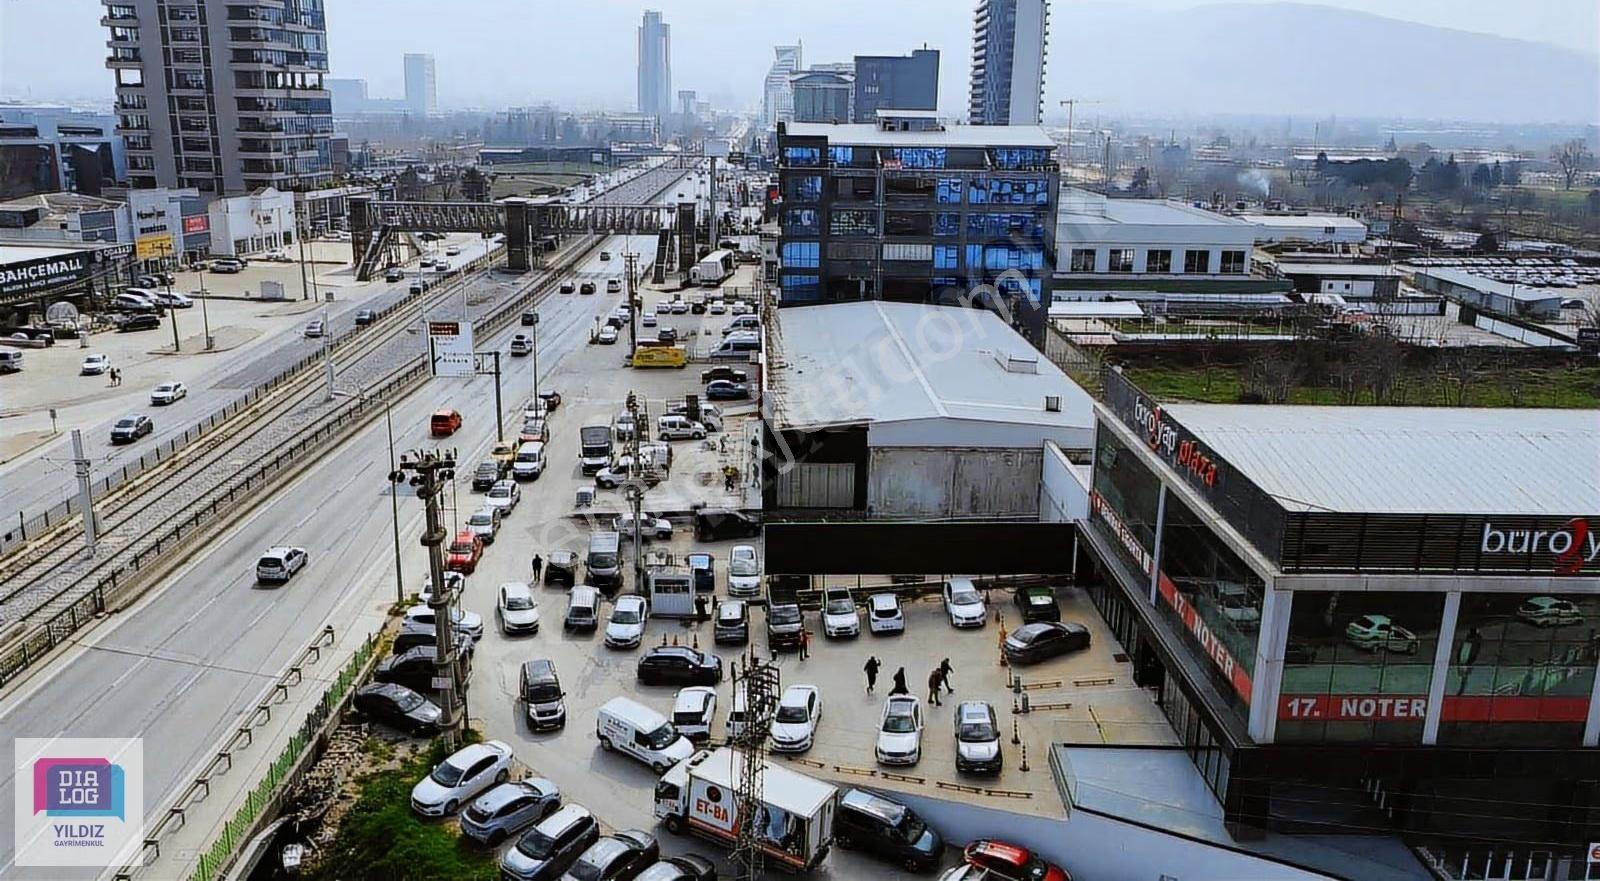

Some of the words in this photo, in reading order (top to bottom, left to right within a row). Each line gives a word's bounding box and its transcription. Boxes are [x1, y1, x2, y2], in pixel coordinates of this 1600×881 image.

[0, 258, 83, 284] BAHÇEMALL
[1177, 440, 1217, 488] plaza
[1193, 617, 1234, 679] NOTER
[1287, 698, 1320, 719] 17.
[1341, 697, 1427, 719] NOTER
